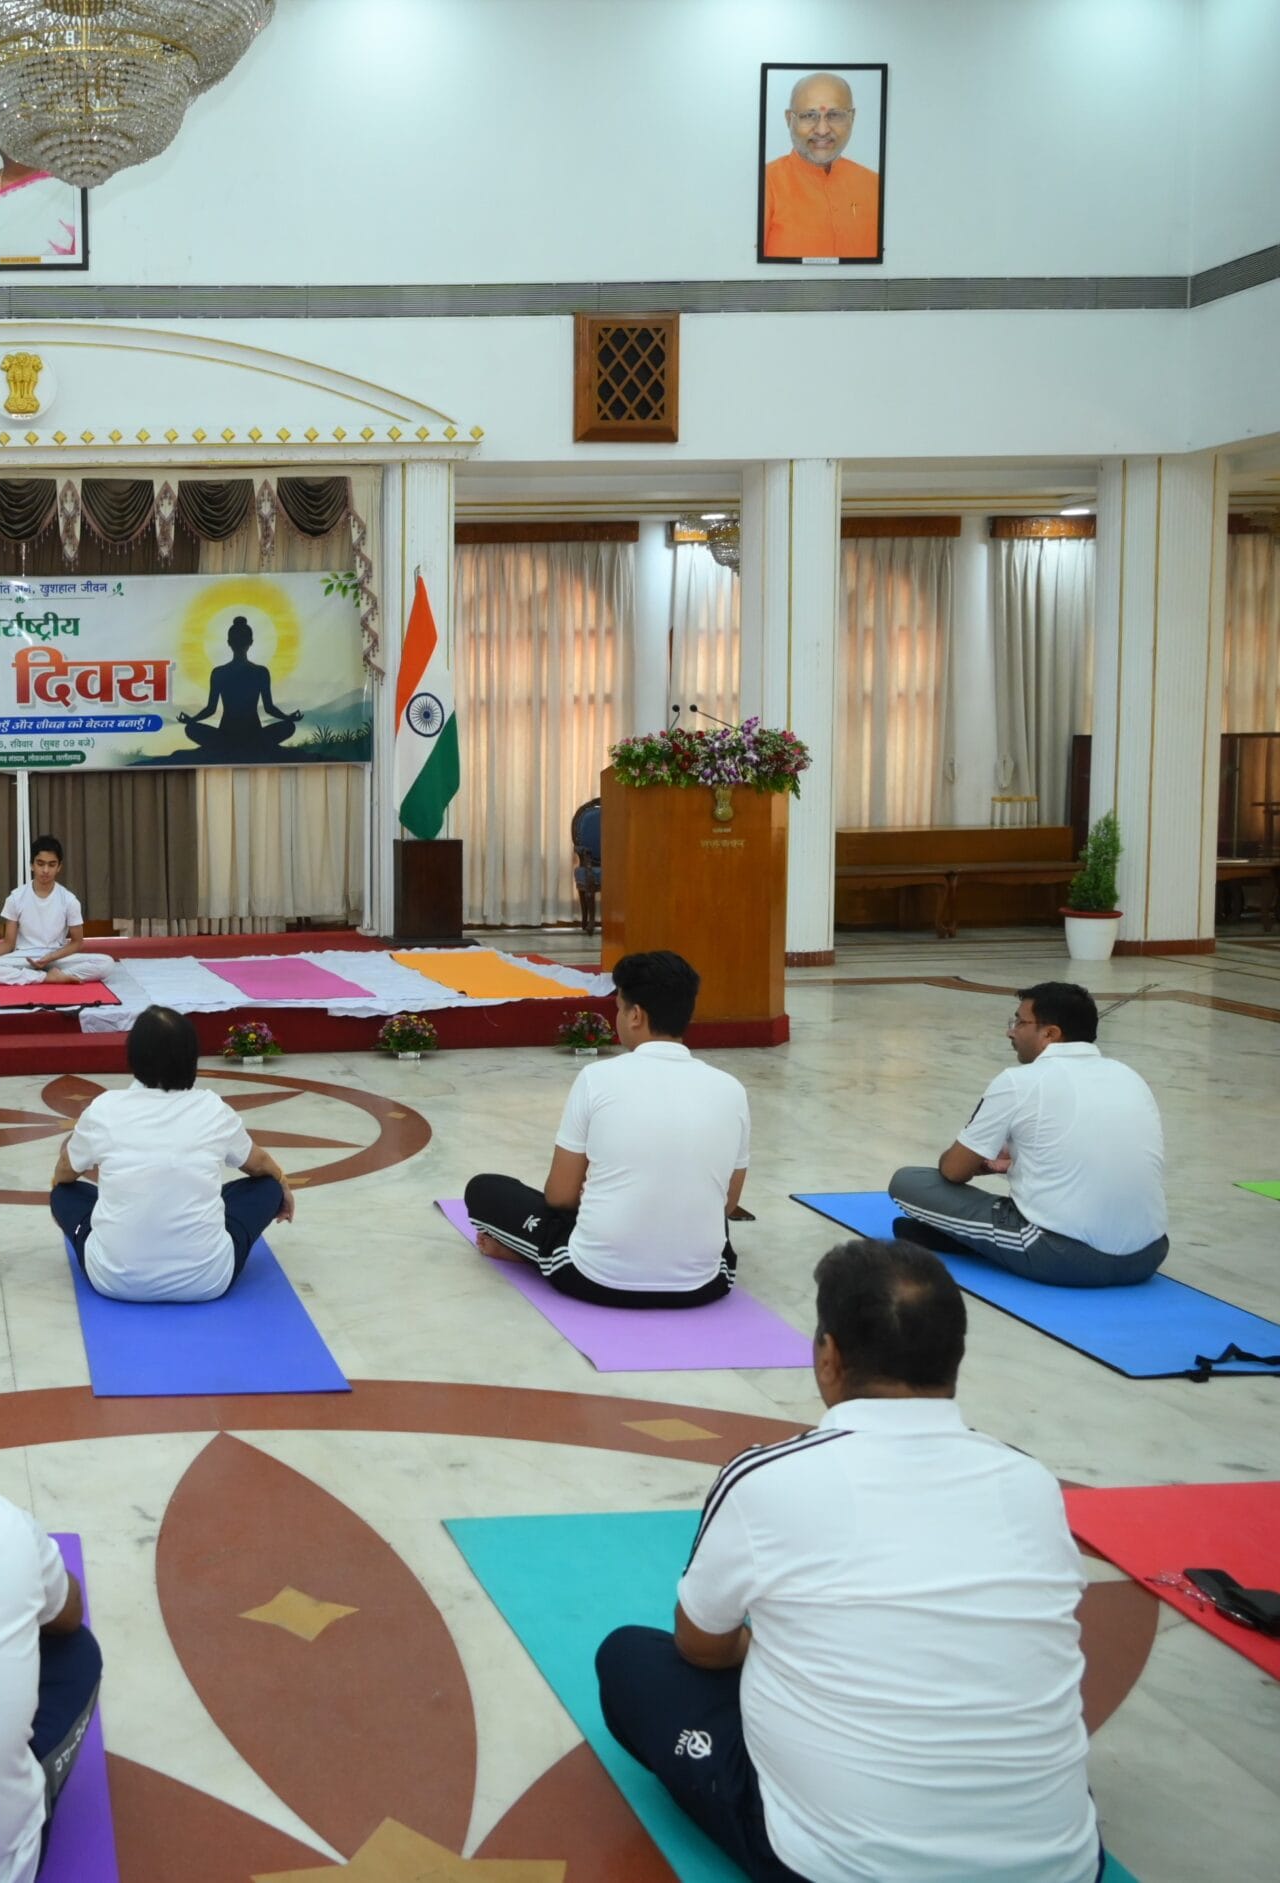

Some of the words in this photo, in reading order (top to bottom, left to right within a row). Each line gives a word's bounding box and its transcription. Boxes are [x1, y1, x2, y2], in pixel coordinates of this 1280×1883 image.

[40, 583, 76, 597] खुशहाल
[80, 580, 108, 593] जीवन
[12, 646, 172, 708] दिवस
[12, 719, 34, 730] और
[36, 719, 64, 730] जीवन
[68, 718, 83, 728] को
[86, 718, 116, 729] बेहतर
[10, 738, 33, 748] रविवार
[40, 738, 60, 751] (सुबह
[63, 739, 74, 747] 09
[78, 737, 95, 748] बजे)
